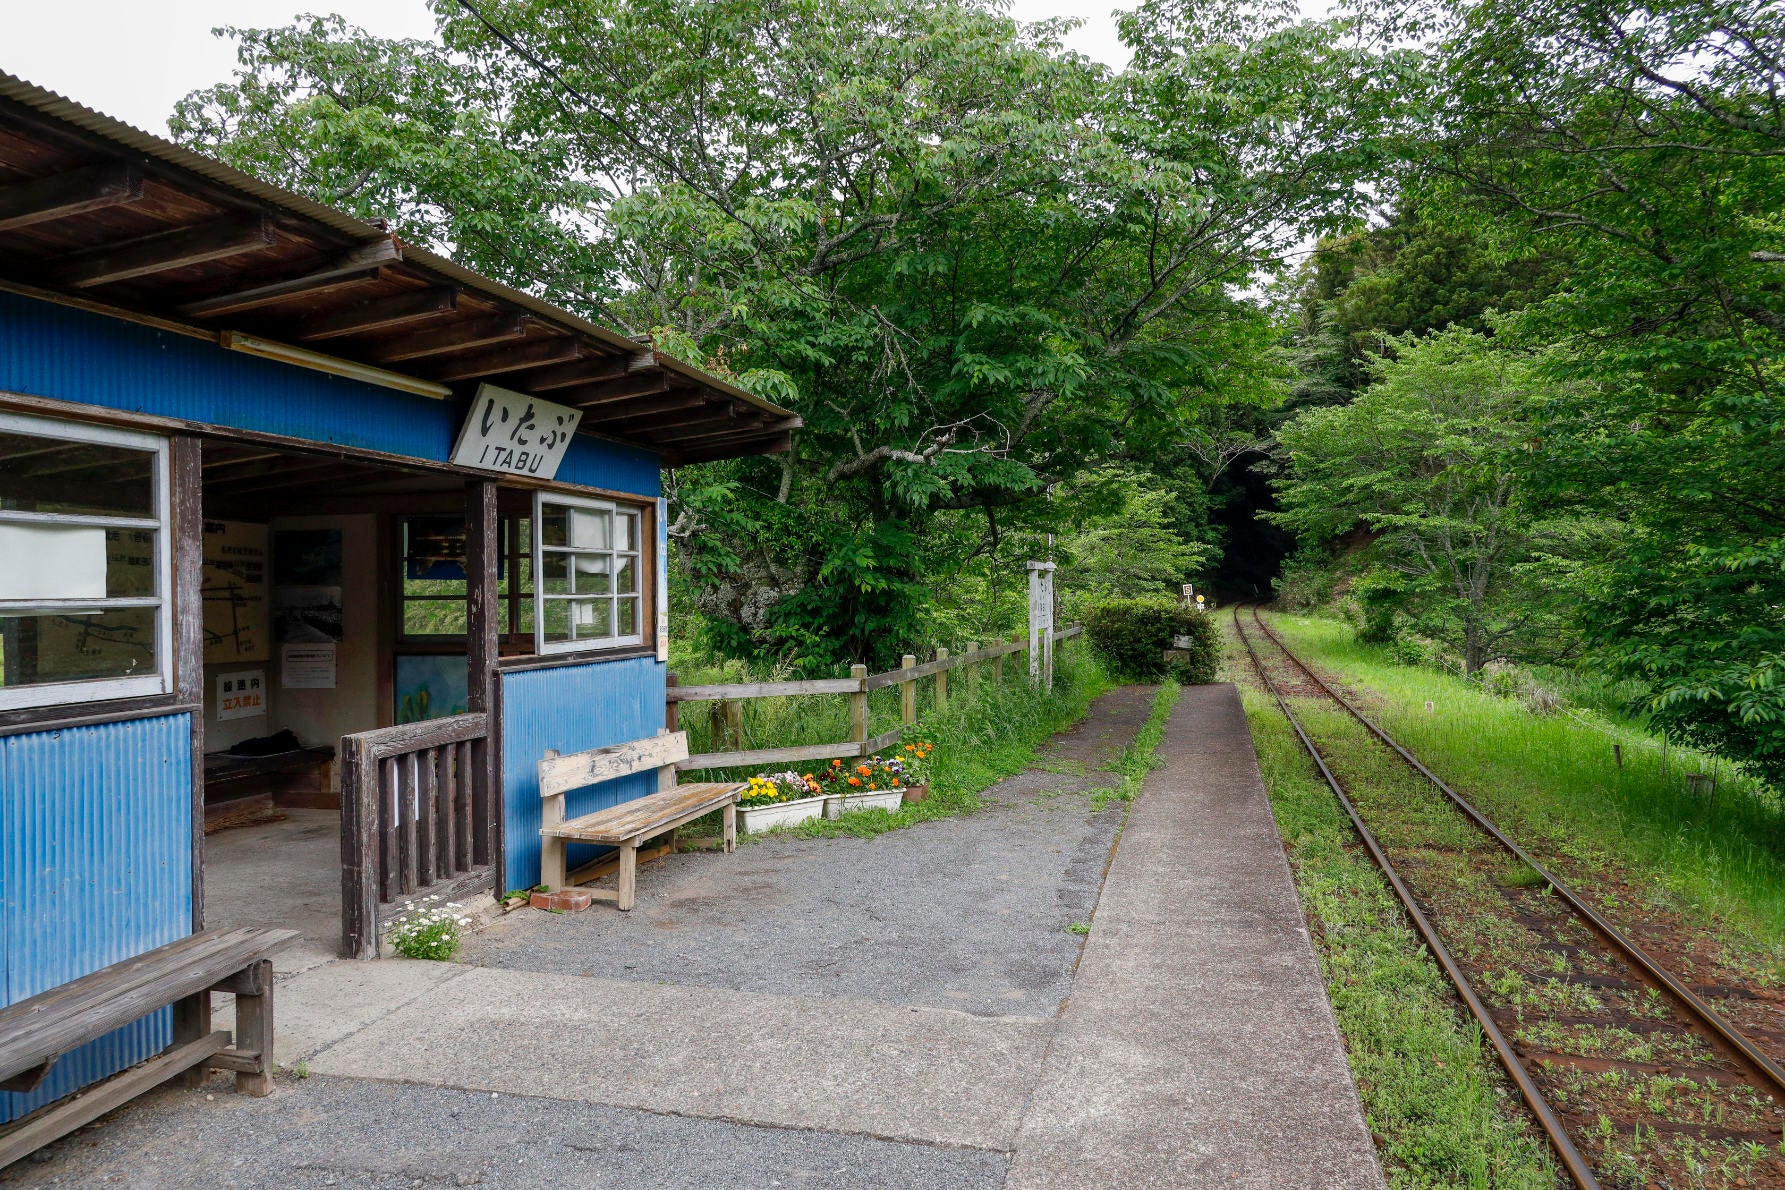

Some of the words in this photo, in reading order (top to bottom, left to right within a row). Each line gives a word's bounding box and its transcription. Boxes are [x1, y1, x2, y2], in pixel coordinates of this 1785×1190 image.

[481, 398, 575, 450] いたぶ
[479, 444, 544, 474] ITABU
